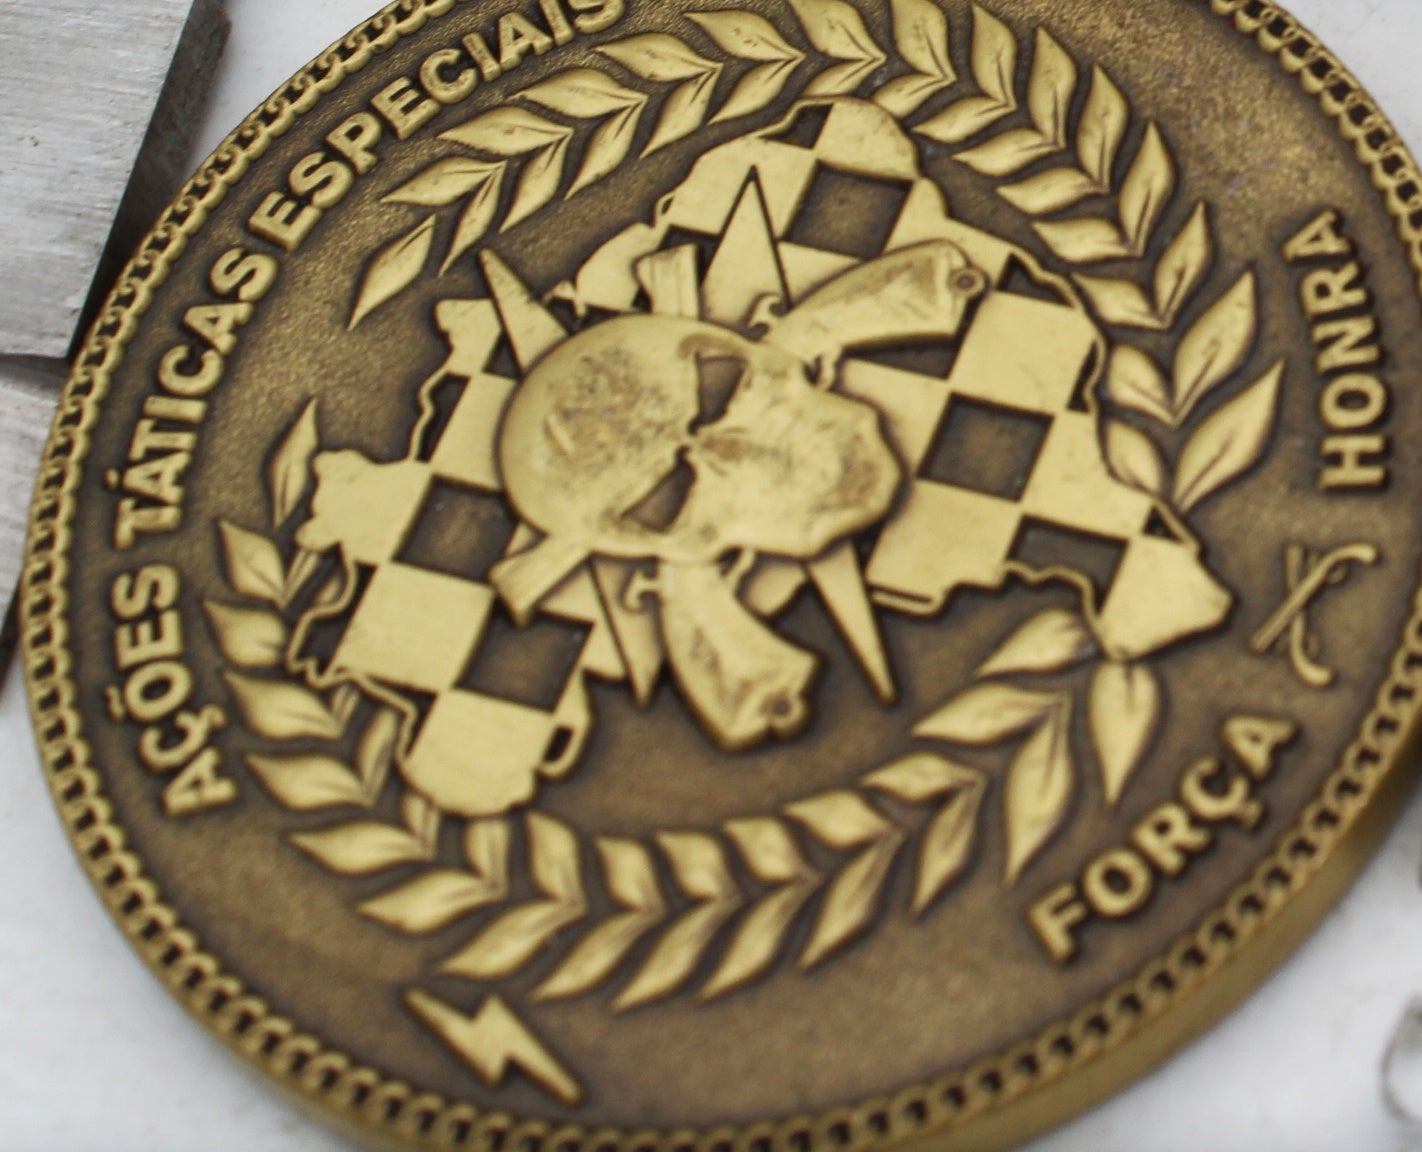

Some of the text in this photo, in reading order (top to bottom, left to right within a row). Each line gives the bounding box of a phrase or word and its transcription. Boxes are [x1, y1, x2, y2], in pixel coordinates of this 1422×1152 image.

[104, 248, 278, 551] TÁTICAS
[1282, 207, 1389, 491] HONRA
[107, 562, 236, 818] AÇÕES
[1028, 714, 1299, 965] FORÇA
